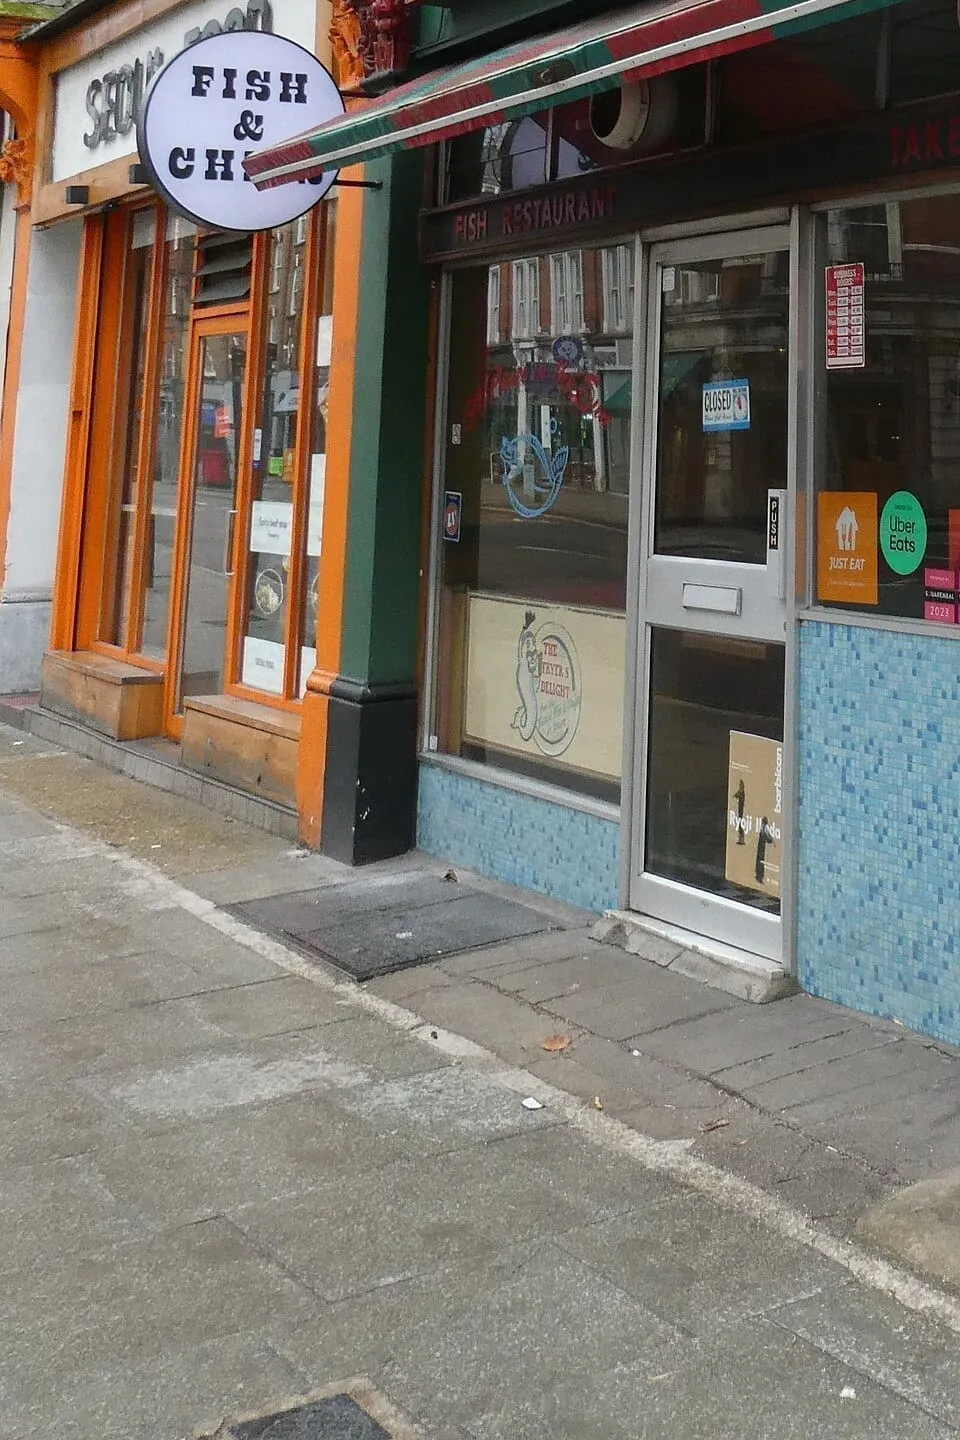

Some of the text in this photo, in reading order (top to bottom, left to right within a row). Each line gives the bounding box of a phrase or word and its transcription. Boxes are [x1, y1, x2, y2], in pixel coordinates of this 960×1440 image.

[191, 65, 308, 104] FISH
[233, 110, 264, 141] &
[455, 186, 617, 246] FISH RESTAURANT
[705, 390, 731, 412] CLOSED
[889, 515, 916, 534] Uber
[889, 534, 916, 553] Eats
[829, 556, 865, 571] JUST EAT
[930, 606, 949, 617] 2023
[543, 642, 558, 657] THE
[540, 680, 570, 700] DELIGHT
[774, 747, 782, 814] barbican
[729, 809, 752, 837] Ryoji
